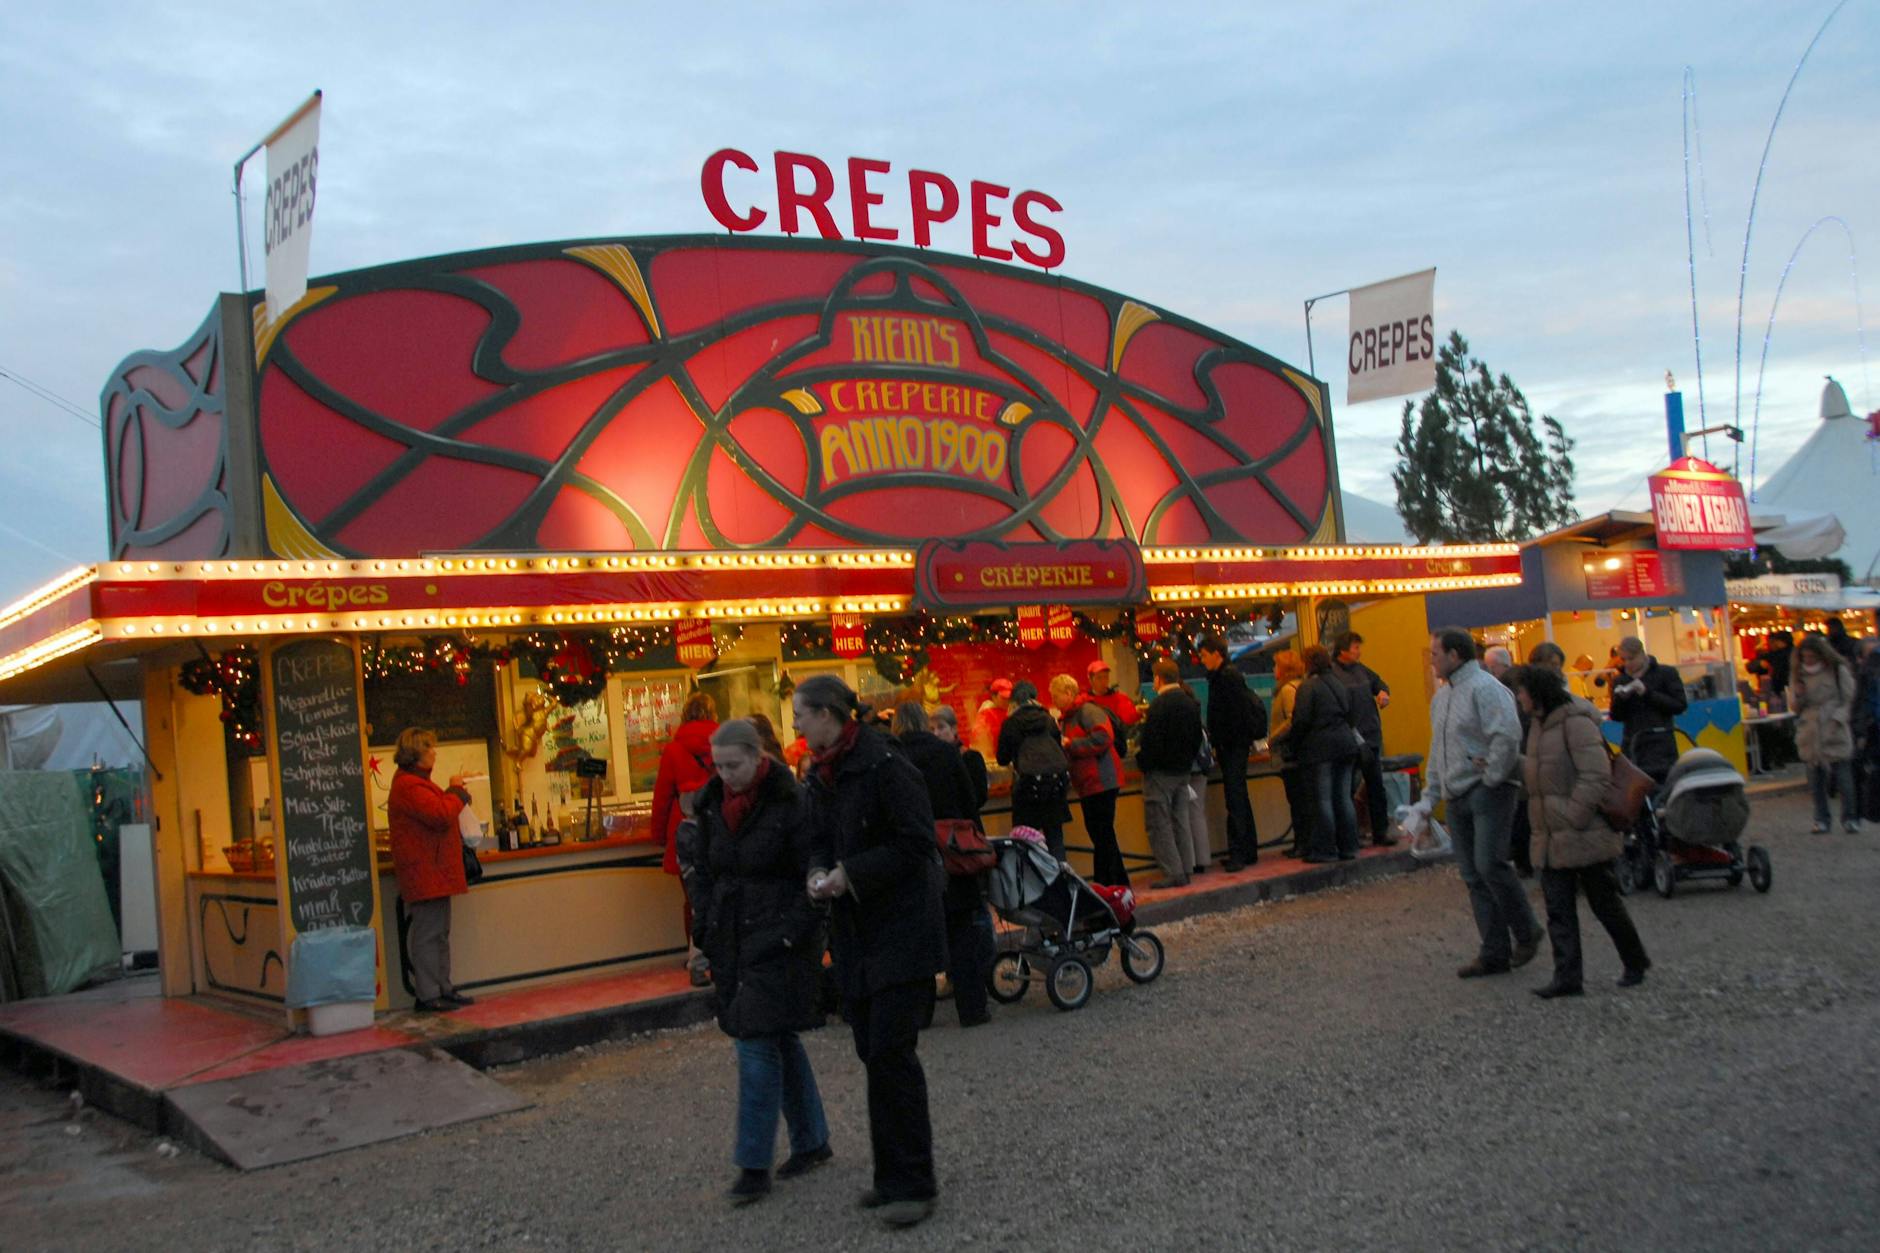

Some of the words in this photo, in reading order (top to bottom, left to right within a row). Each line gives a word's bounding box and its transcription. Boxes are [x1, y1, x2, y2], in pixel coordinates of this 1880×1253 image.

[265, 146, 318, 256] CREPES
[701, 148, 1065, 268] CREPES
[1349, 314, 1433, 374] CREPES
[830, 381, 991, 422] CREPERIE
[820, 417, 925, 485] ANNO
[925, 418, 1008, 481] 1900
[1021, 627, 1044, 641] HIER
[1050, 626, 1073, 640] HIER
[1138, 623, 1158, 635] HIER
[680, 644, 711, 659] HIER
[835, 637, 863, 651] HIER
[295, 704, 349, 724] Tomate
[316, 813, 365, 839] Pfeffer
